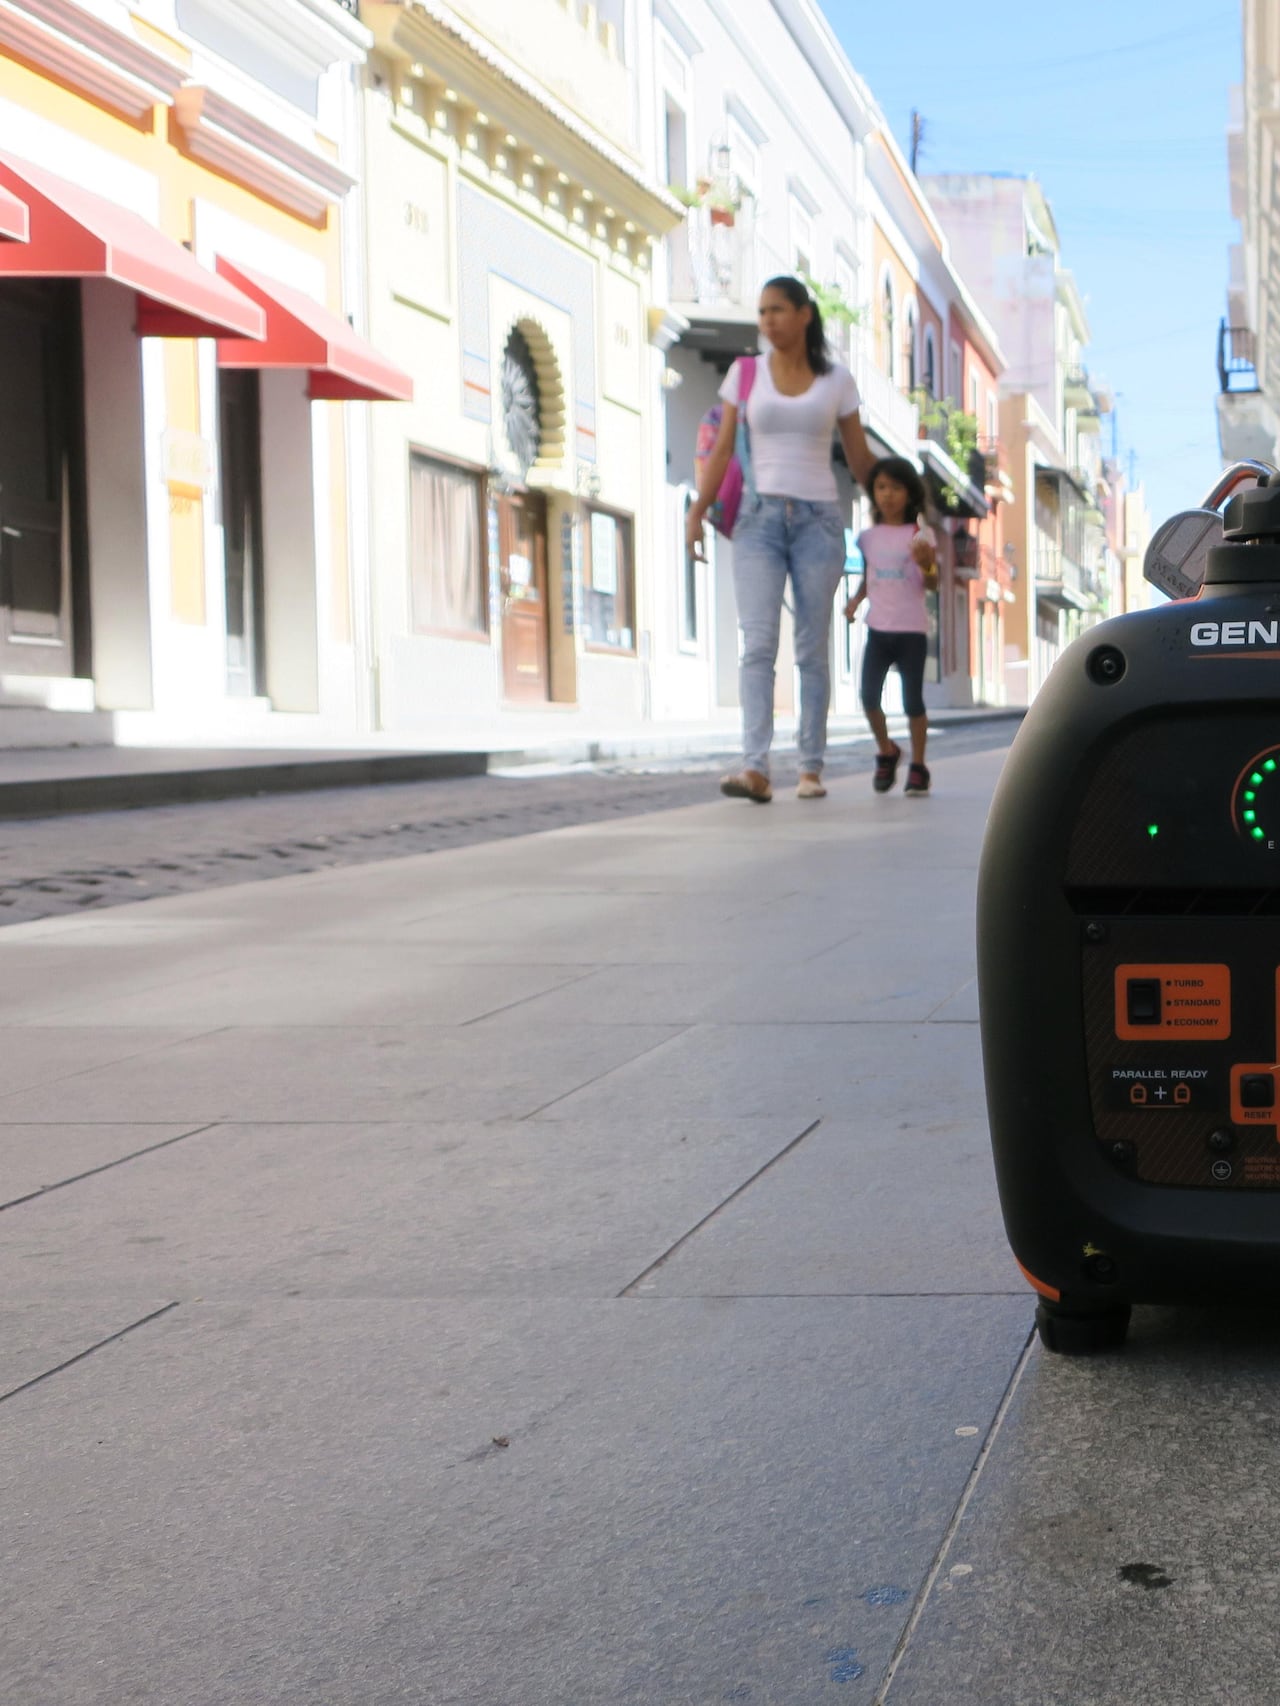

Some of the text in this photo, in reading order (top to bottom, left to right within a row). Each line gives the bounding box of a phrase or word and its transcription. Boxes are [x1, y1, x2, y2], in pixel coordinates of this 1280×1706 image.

[1150, 560, 1197, 597] Mast
[1267, 840, 1275, 850] E
[1173, 979, 1204, 988] TURBO
[1173, 999, 1221, 1007] STANDARD
[1173, 1018, 1219, 1027] ECONOMY
[1112, 1070, 1208, 1079] PARALLEL READY
[1243, 1110, 1273, 1120] RESET
